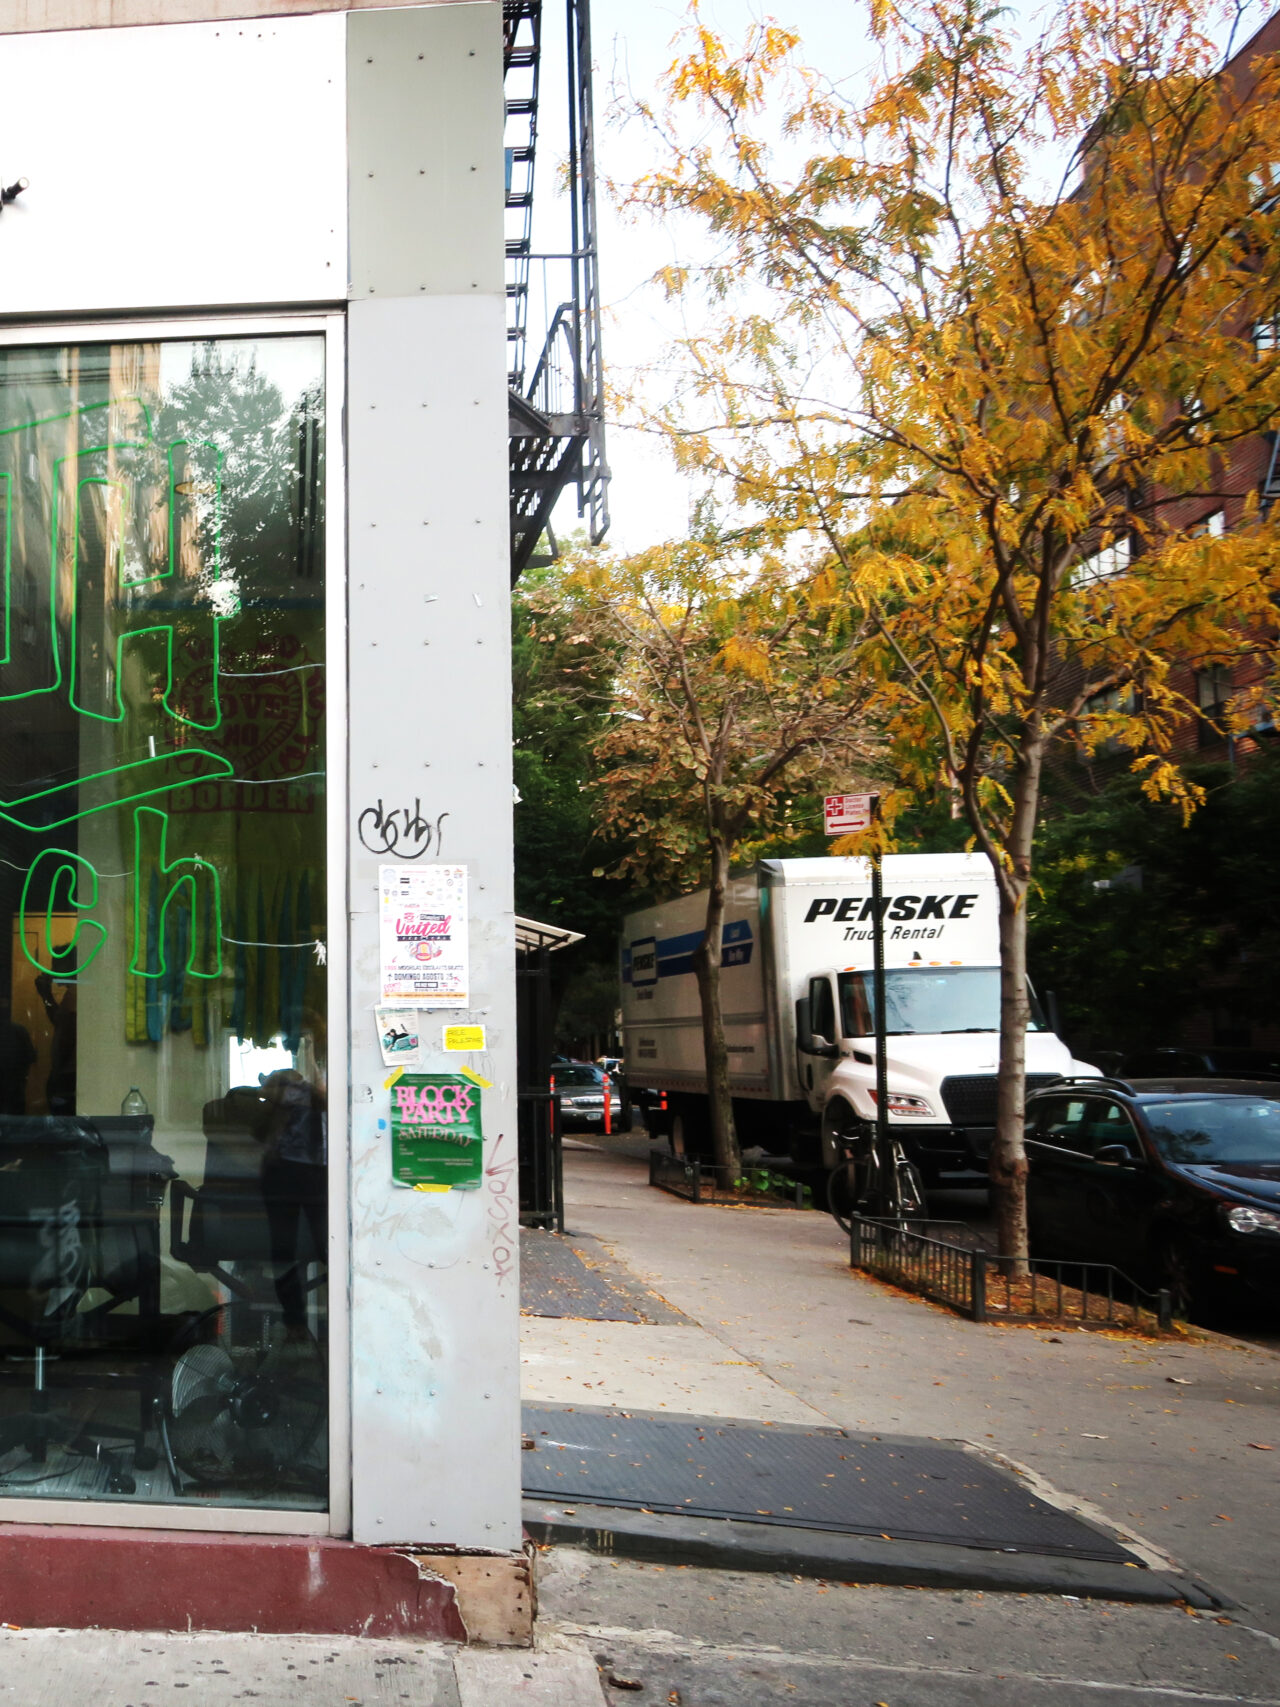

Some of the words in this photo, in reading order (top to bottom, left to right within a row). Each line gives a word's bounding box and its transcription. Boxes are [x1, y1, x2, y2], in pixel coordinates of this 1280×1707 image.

[803, 894, 979, 923] PENSKE
[396, 915, 452, 936] United
[843, 925, 886, 941] Truc
[890, 924, 945, 940] Rental
[394, 1085, 475, 1107] BLOCK
[400, 1103, 470, 1124] PARTY
